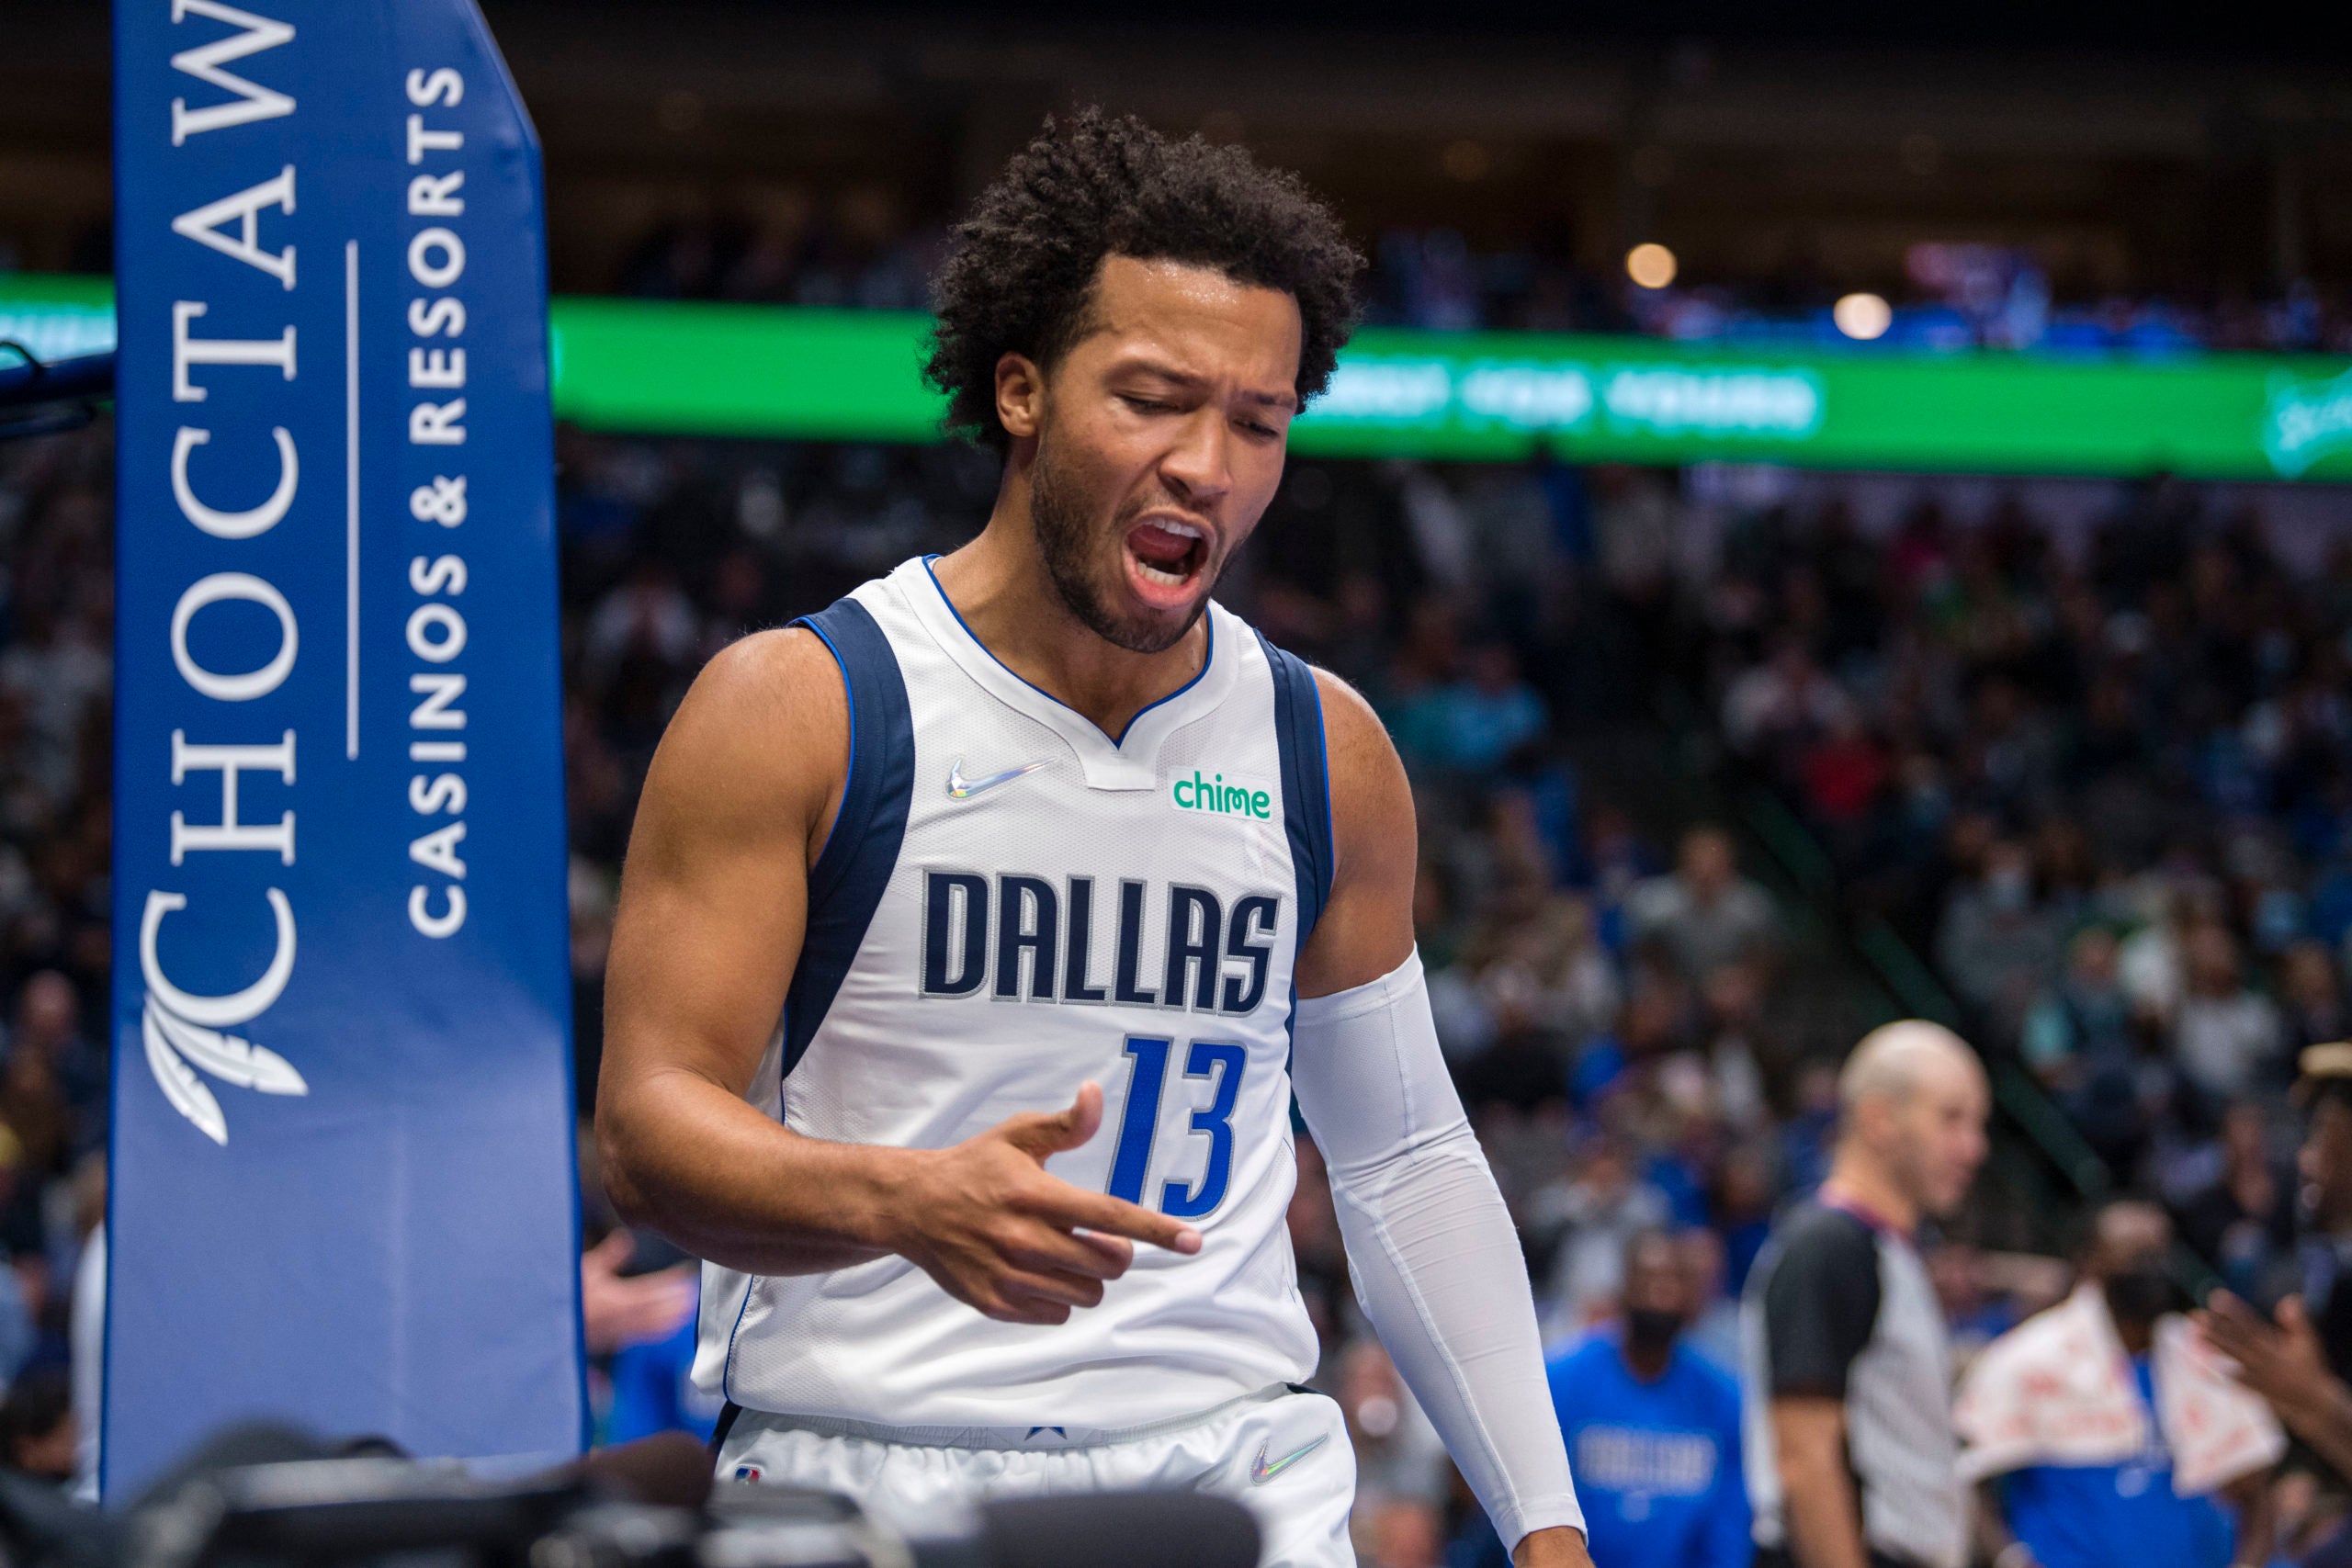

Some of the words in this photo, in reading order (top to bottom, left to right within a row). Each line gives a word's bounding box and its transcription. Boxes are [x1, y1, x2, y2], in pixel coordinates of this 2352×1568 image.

[406, 68, 466, 445] RESORTS
[141, 0, 298, 1028] CHOCTAW
[410, 476, 467, 528] &
[406, 555, 467, 939] CASINOS
[1173, 770, 1272, 819] chime
[919, 867, 1282, 1017] DALLAS
[1105, 1033, 1250, 1222] 13
